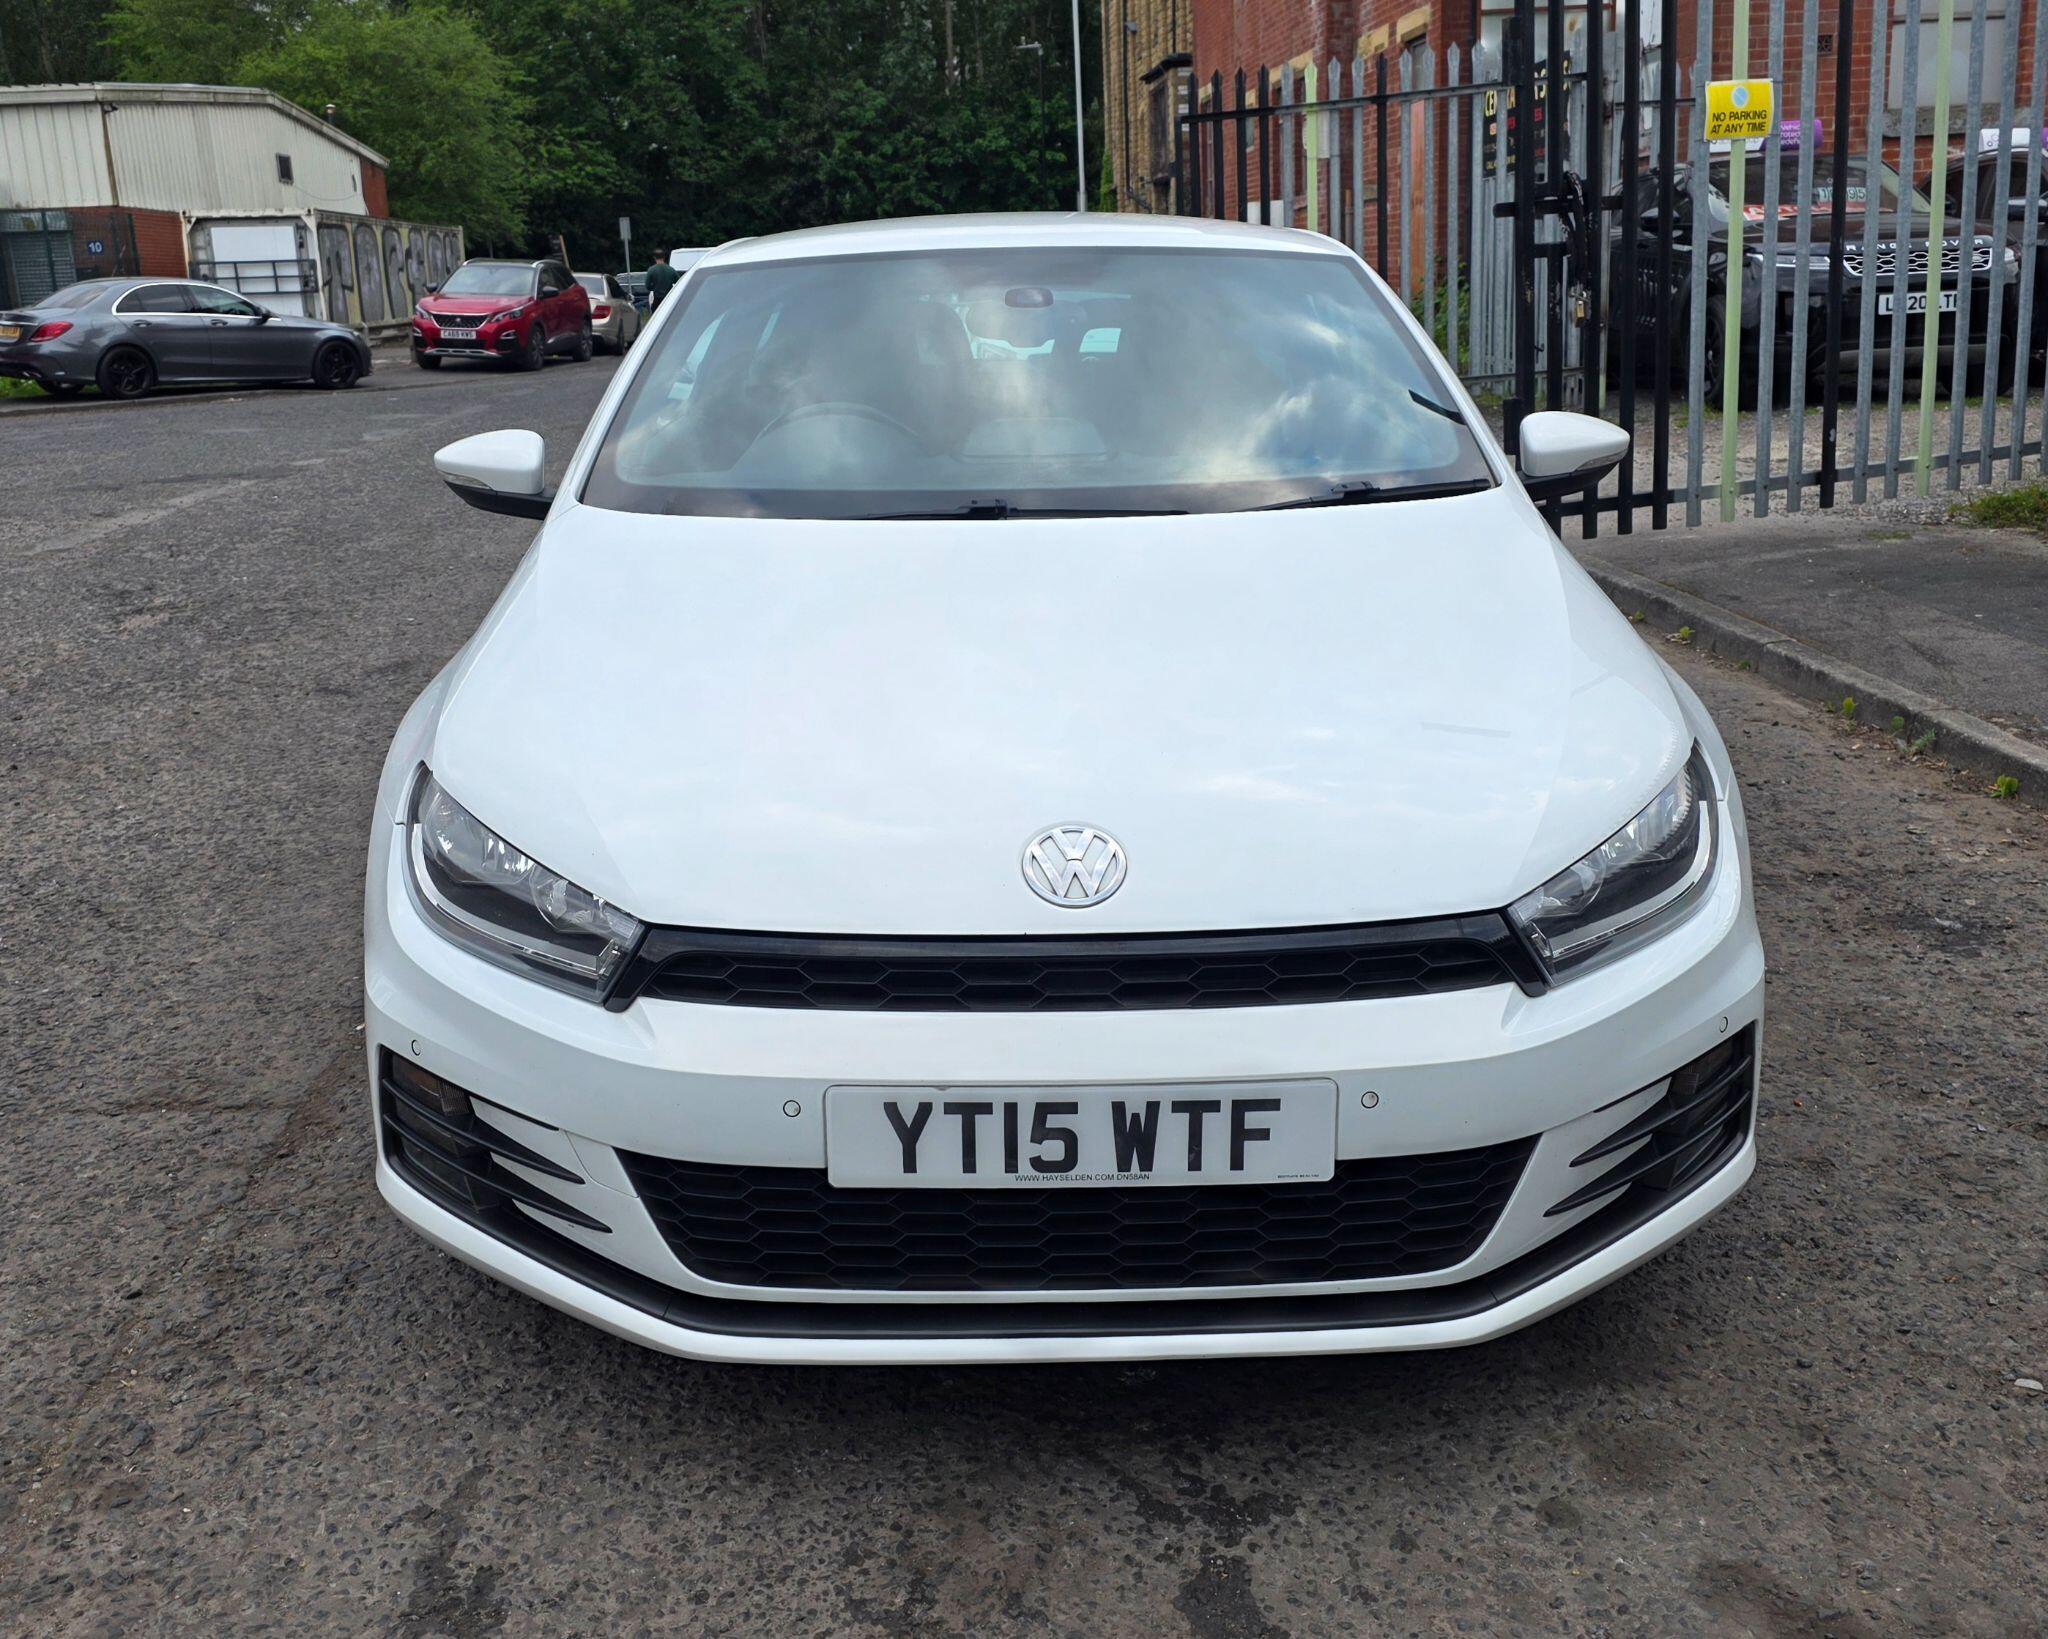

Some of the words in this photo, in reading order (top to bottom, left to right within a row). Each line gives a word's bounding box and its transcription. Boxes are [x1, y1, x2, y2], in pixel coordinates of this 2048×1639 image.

[1712, 112, 1727, 122] NO
[1728, 110, 1767, 121] PARKING
[1711, 124, 1723, 134] AT
[1724, 124, 1744, 133] ANY
[1746, 122, 1767, 132] TIME
[89, 241, 103, 253] 10
[1112, 1098, 1282, 1172] WTF
